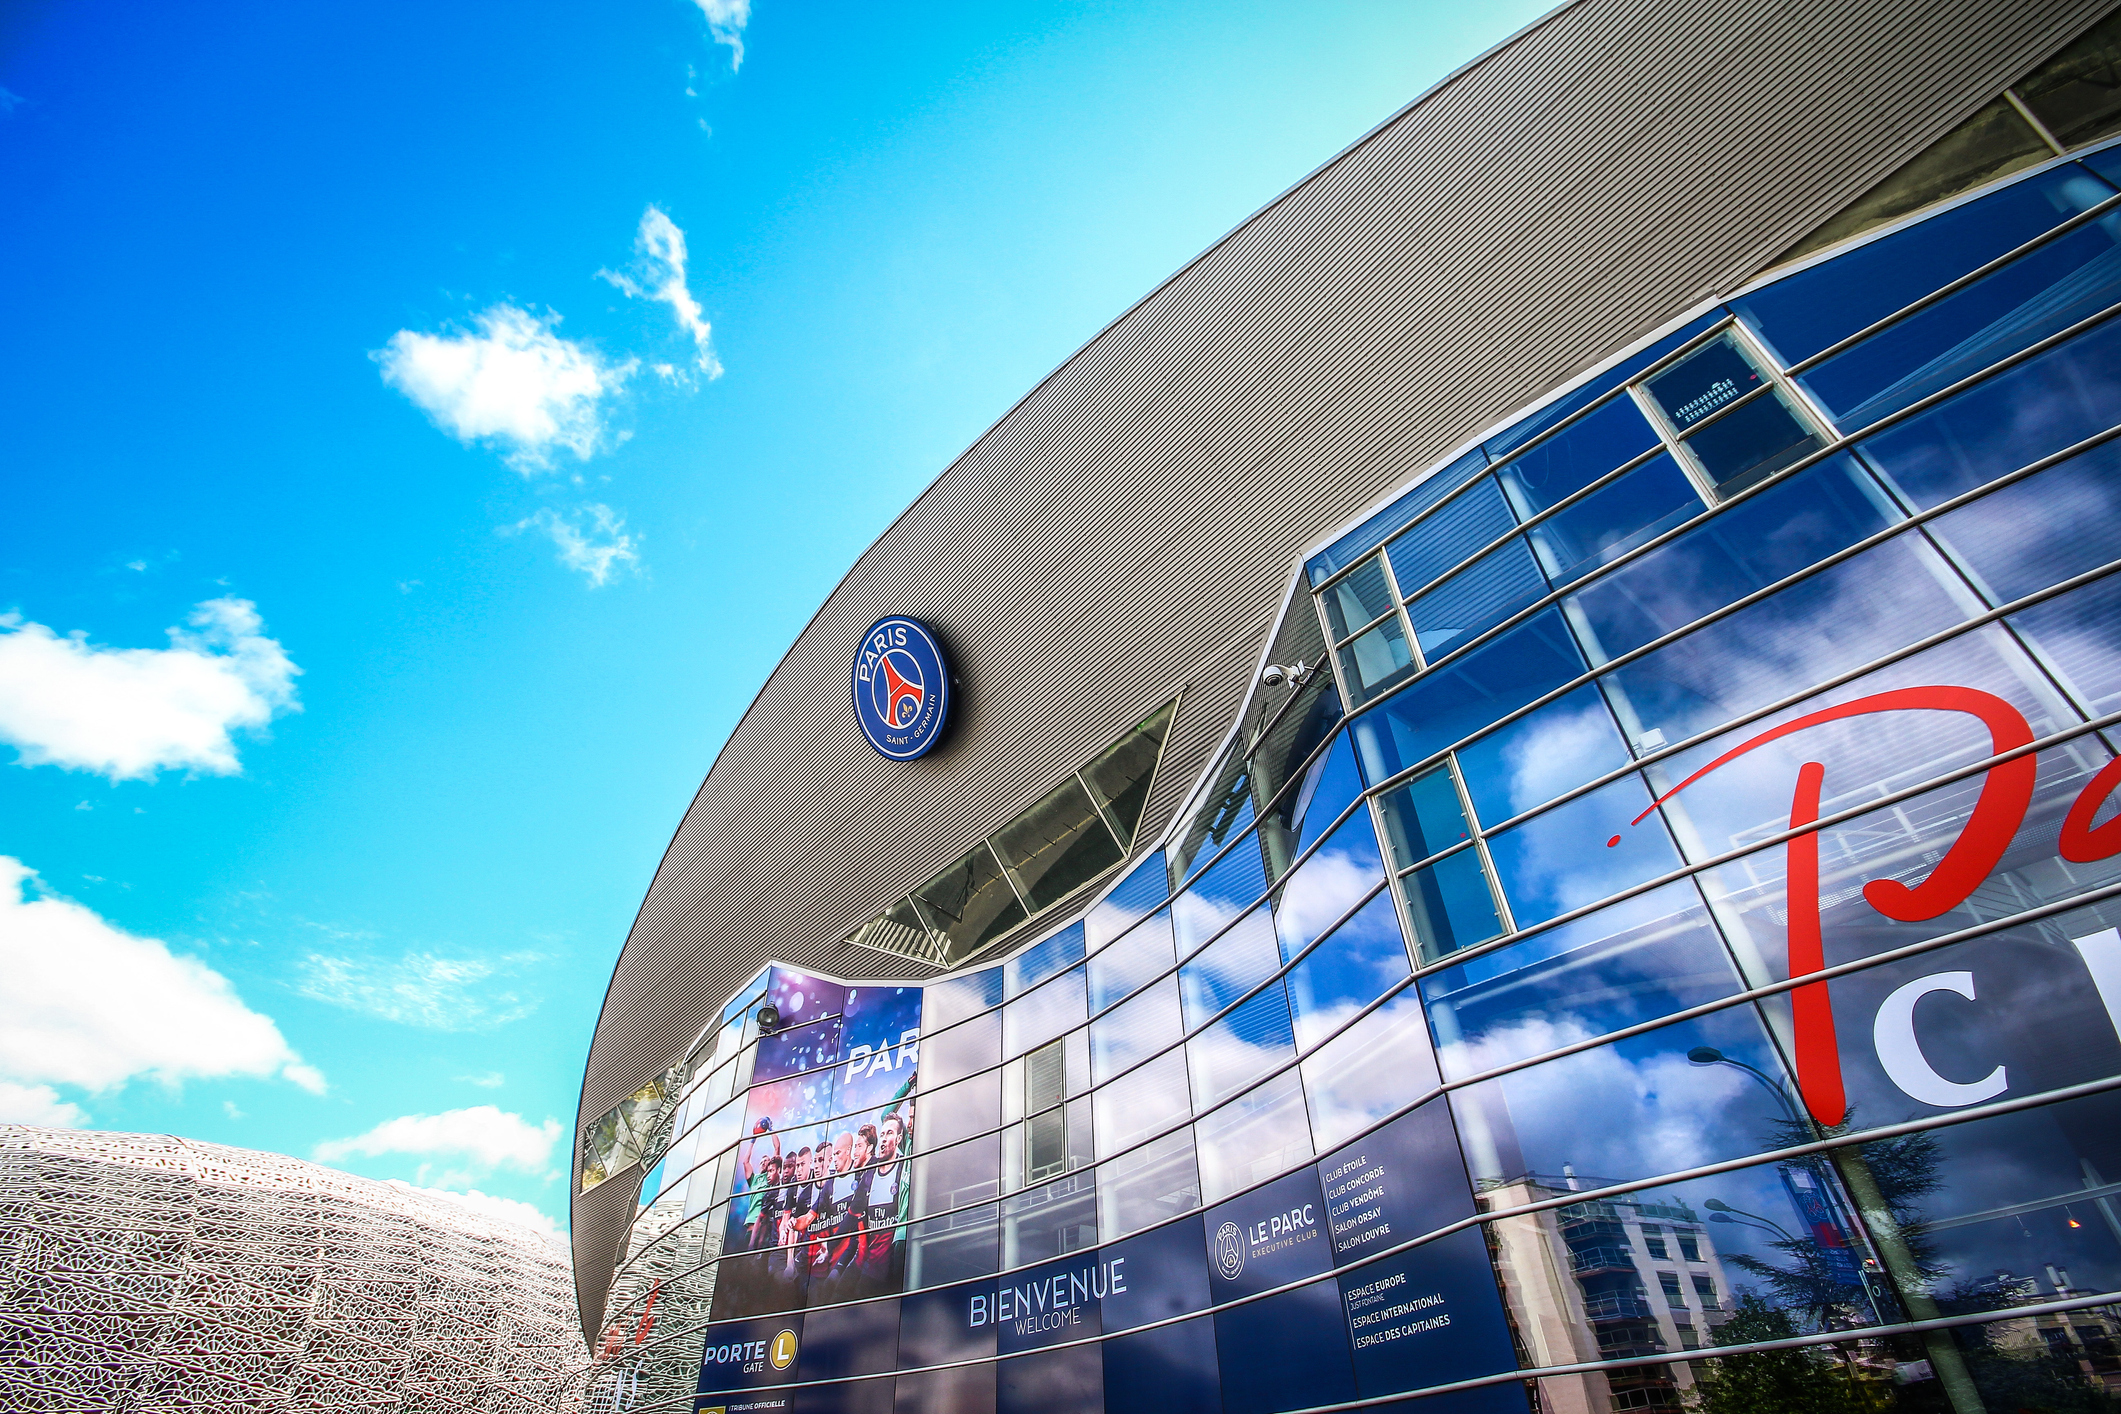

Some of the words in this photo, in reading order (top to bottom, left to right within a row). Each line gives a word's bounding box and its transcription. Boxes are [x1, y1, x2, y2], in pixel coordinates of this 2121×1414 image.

[860, 627, 907, 682] PARIS
[1326, 1167, 1343, 1183] CLUB
[1343, 1155, 1367, 1172] ÉTOILE
[1329, 1185, 1346, 1200] CLUB
[1346, 1165, 1385, 1191] CONCORDE
[874, 1207, 886, 1219] Fly
[1332, 1201, 1350, 1217] CLUB
[1349, 1185, 1385, 1208] VENDÔME
[1218, 1224, 1237, 1241] PARIS
[1249, 1221, 1269, 1246] LE
[1270, 1203, 1315, 1238] PARC
[1335, 1217, 1358, 1235] SALON
[1358, 1206, 1381, 1225] ORSAY
[1252, 1237, 1294, 1259] EXECUTIVE
[1296, 1229, 1318, 1243] CLUB
[1338, 1235, 1361, 1252] SALON
[1361, 1223, 1391, 1243] LOUVRE
[970, 1257, 1127, 1328] BIENVENUE
[1347, 1283, 1375, 1301] ESPACE
[1375, 1273, 1406, 1292] EUROPE
[1015, 1306, 1081, 1336] WELCOME
[1352, 1311, 1380, 1329] ESPACE
[1380, 1293, 1445, 1321] INTERNATIONAL
[1356, 1331, 1385, 1349] ESPACE
[1384, 1327, 1401, 1341] DES
[1401, 1314, 1451, 1336] CAPITAINES
[703, 1340, 767, 1366] PORTE
[777, 1338, 790, 1361] L
[743, 1362, 763, 1373] GATE
[754, 1400, 786, 1410] OFFICIELLE
